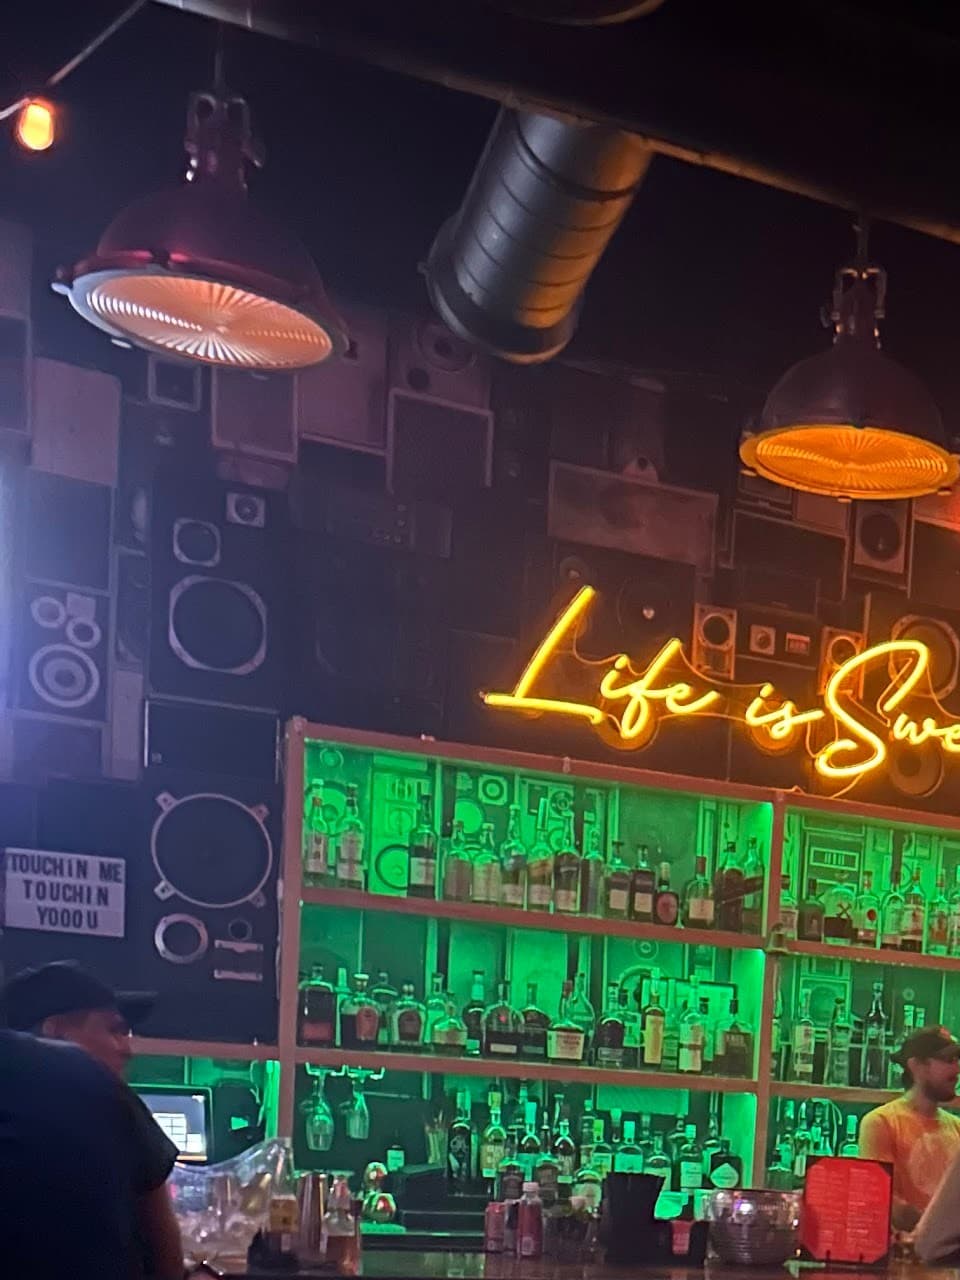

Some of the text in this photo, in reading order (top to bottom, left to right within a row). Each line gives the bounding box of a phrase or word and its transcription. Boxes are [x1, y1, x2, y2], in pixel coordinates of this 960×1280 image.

[483, 584, 721, 740] Life
[744, 683, 826, 740] is
[9, 853, 122, 882] TOUCHIN ME
[24, 880, 109, 906] TOUCHIN
[37, 906, 98, 929] YOOOU
